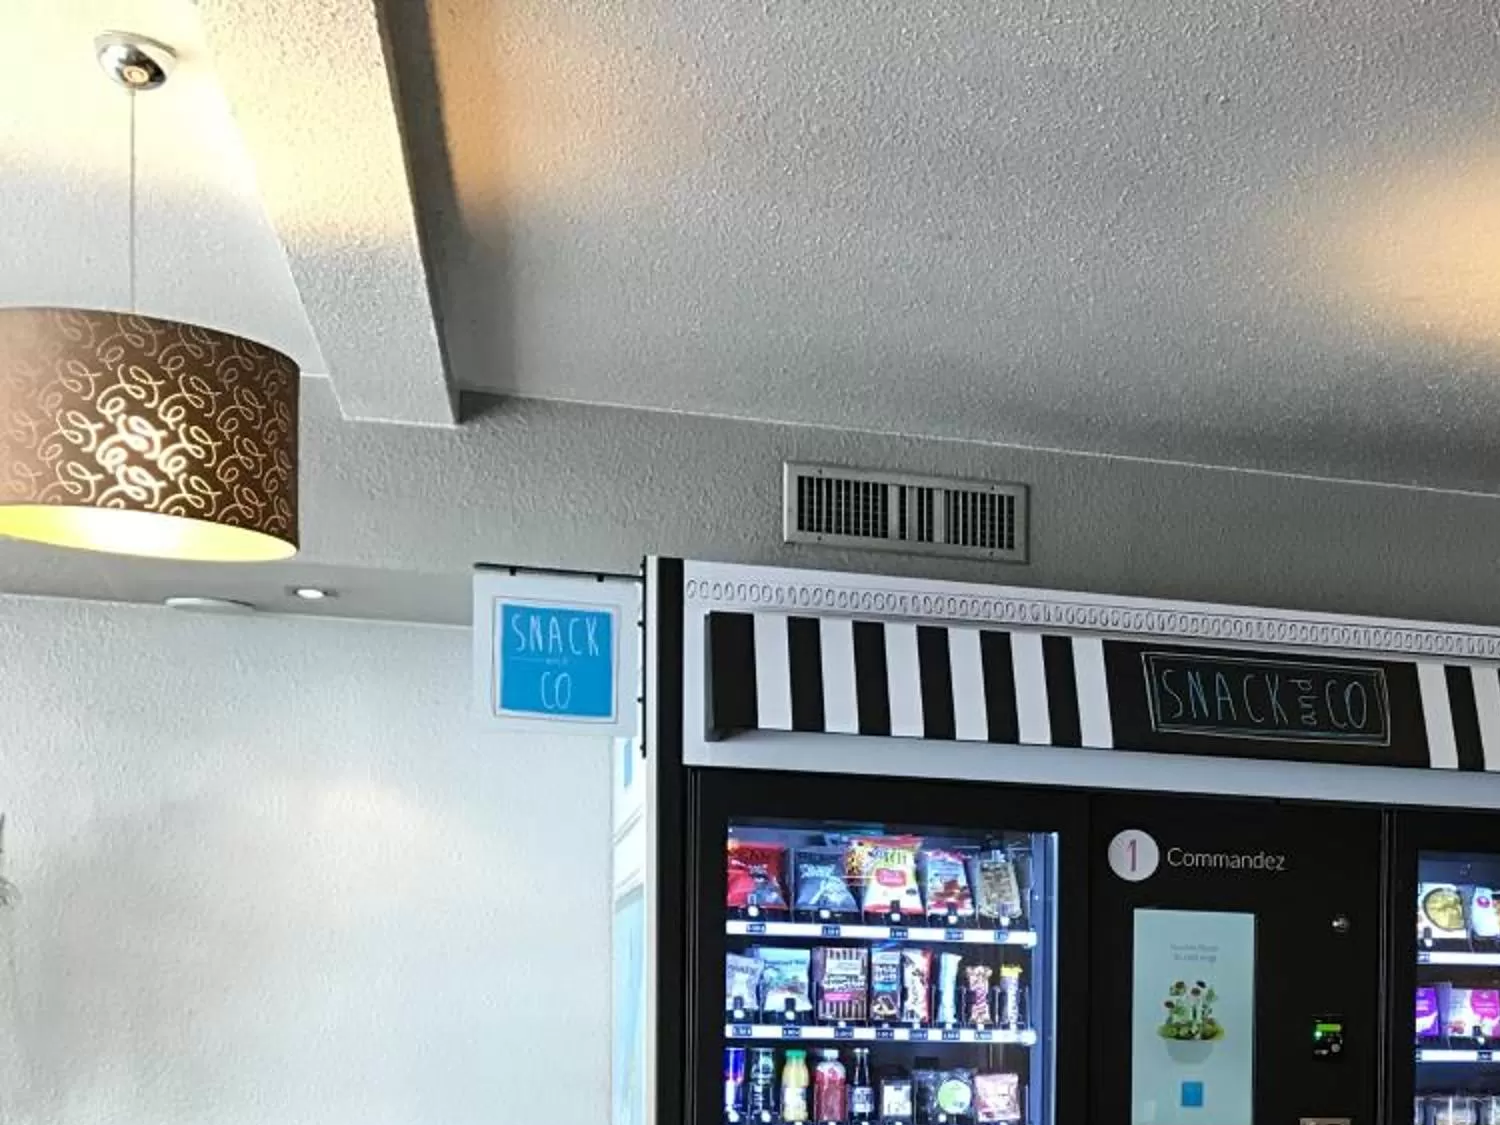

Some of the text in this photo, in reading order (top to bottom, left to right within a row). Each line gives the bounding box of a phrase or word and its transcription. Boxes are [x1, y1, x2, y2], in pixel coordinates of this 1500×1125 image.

[511, 613, 599, 657] SNACK
[541, 671, 572, 709] CO
[1162, 669, 1289, 726] SNACK
[1325, 678, 1368, 730] CO
[1126, 839, 1288, 873] 1 Commandez
